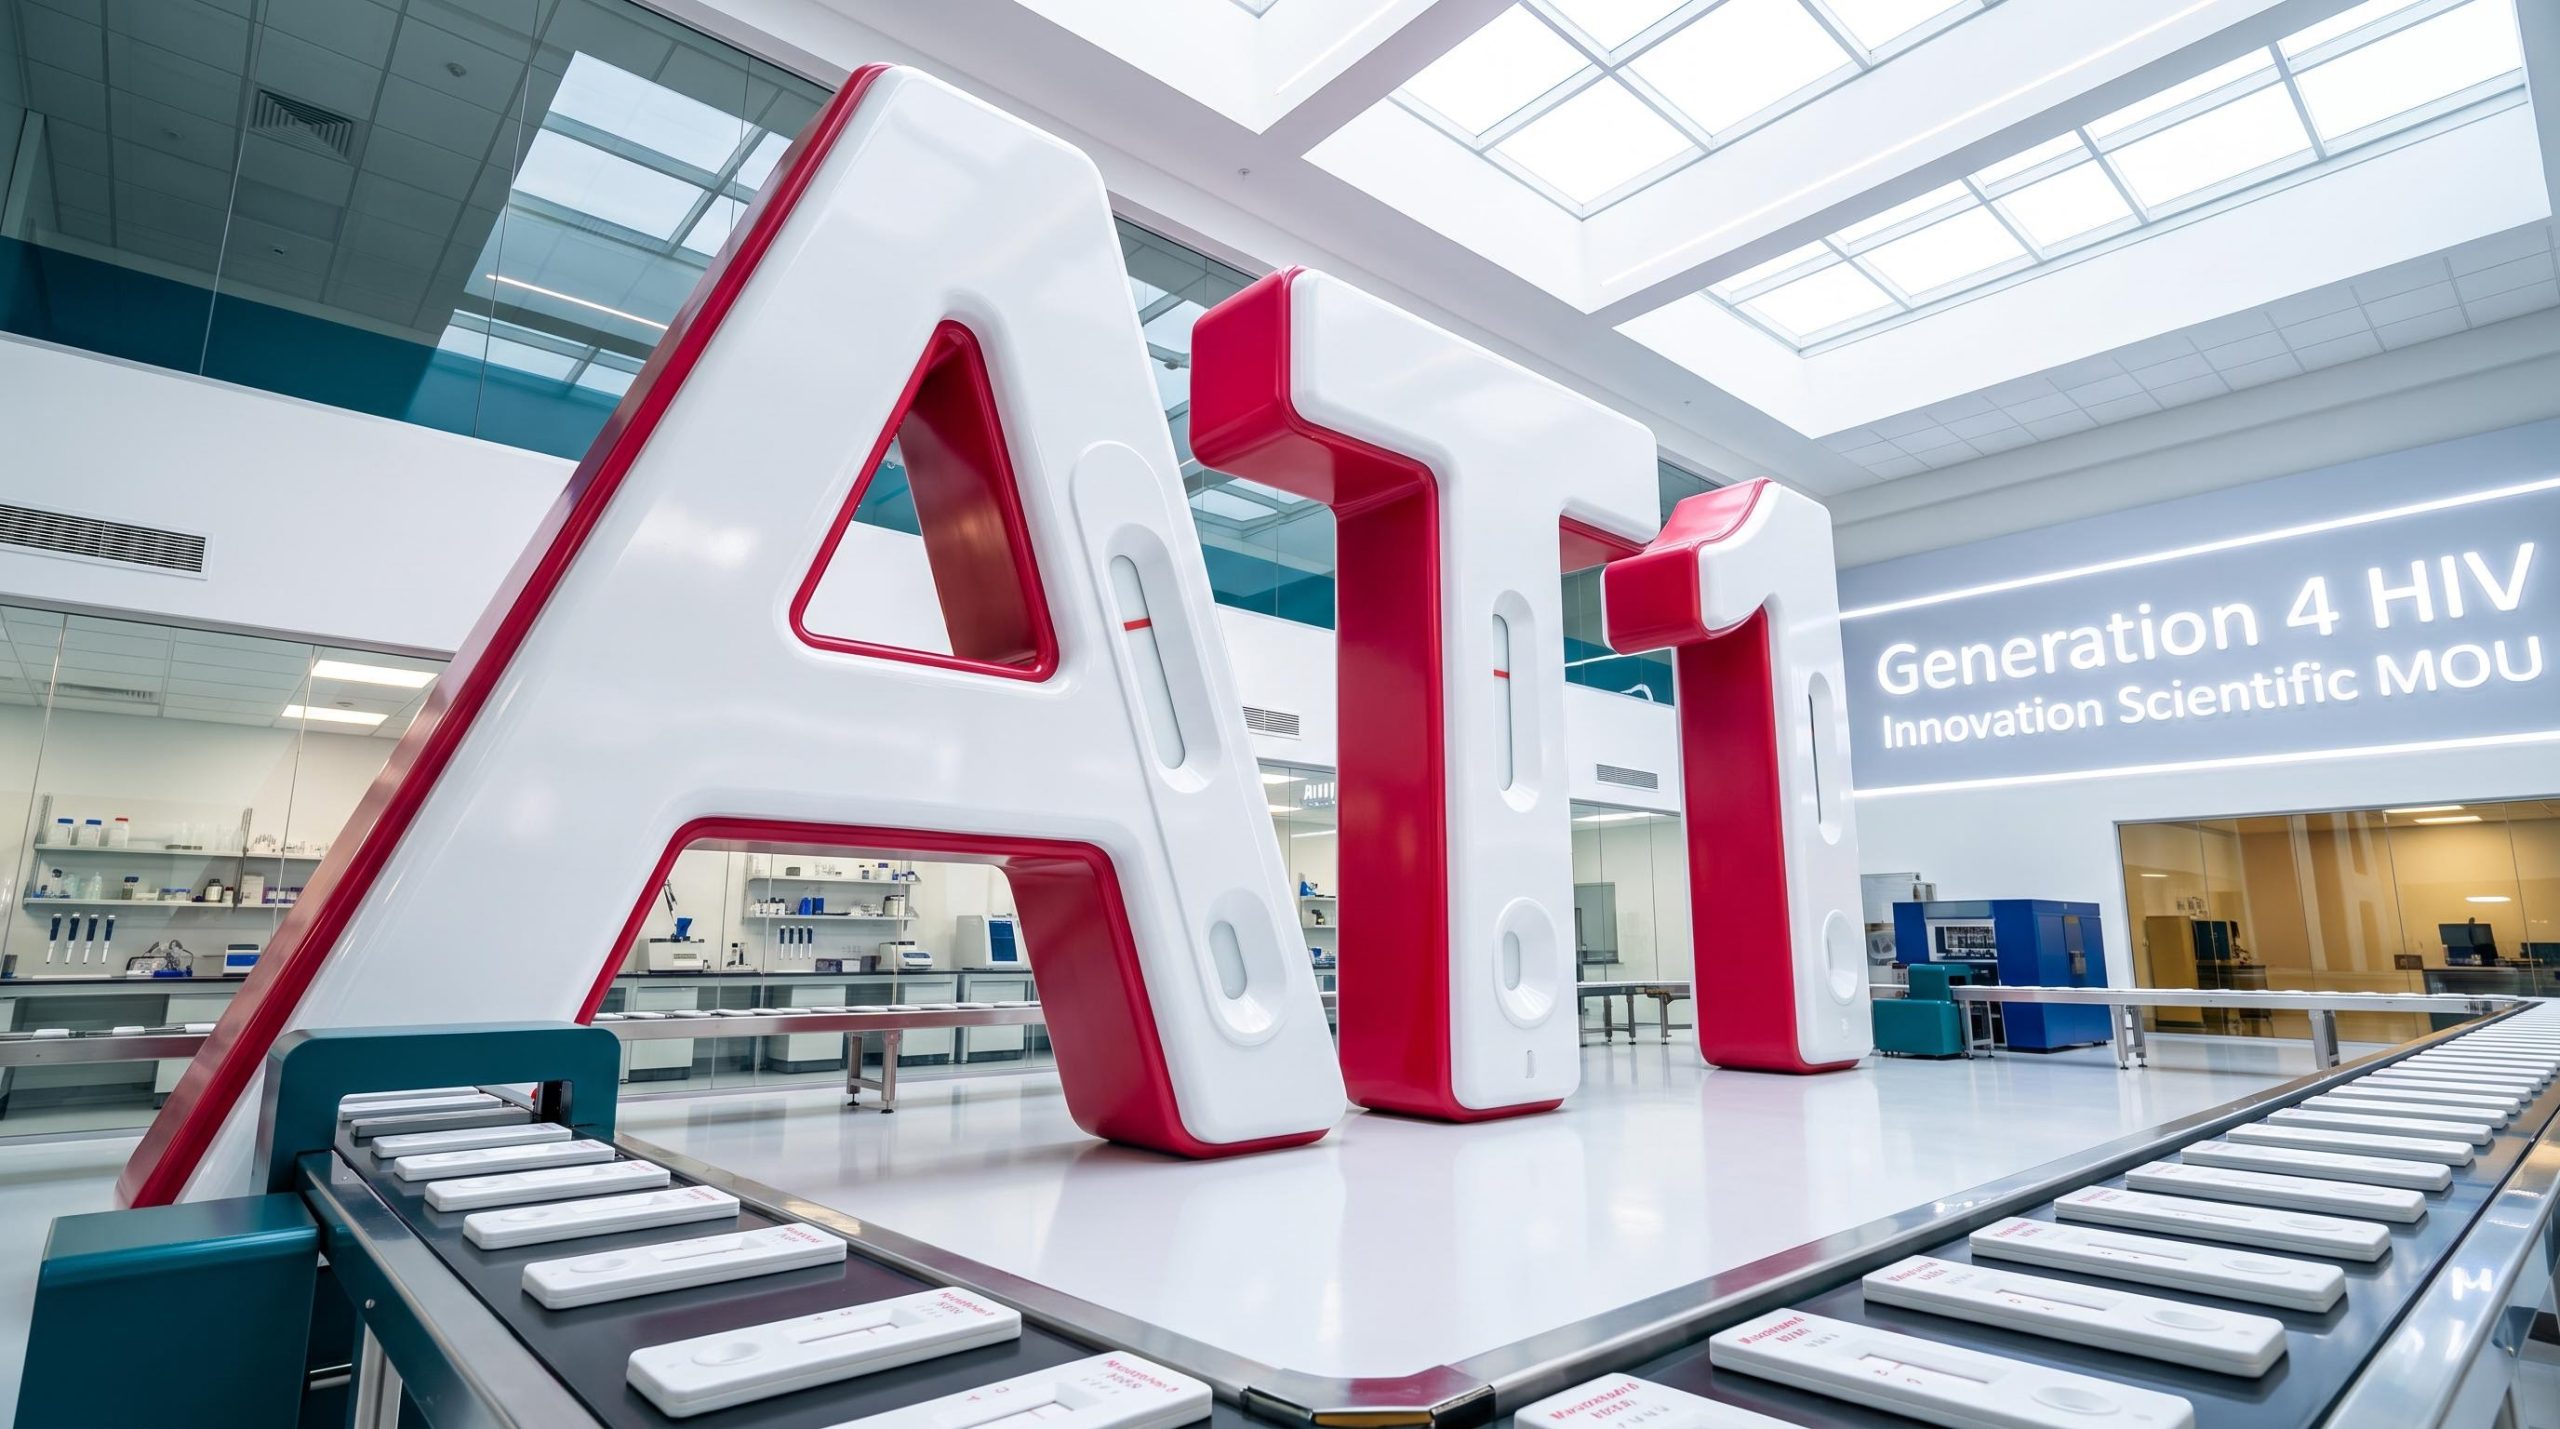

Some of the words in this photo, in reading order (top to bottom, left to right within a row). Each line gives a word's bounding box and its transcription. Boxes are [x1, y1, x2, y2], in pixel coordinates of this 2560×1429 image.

[1876, 602, 2260, 696] Generation
[2285, 575, 2340, 636] 4
[2367, 541, 2536, 630] HIV
[1882, 698, 2105, 750] Innovation
[2117, 660, 2360, 724] Scientific
[2375, 635, 2544, 697] MOU
